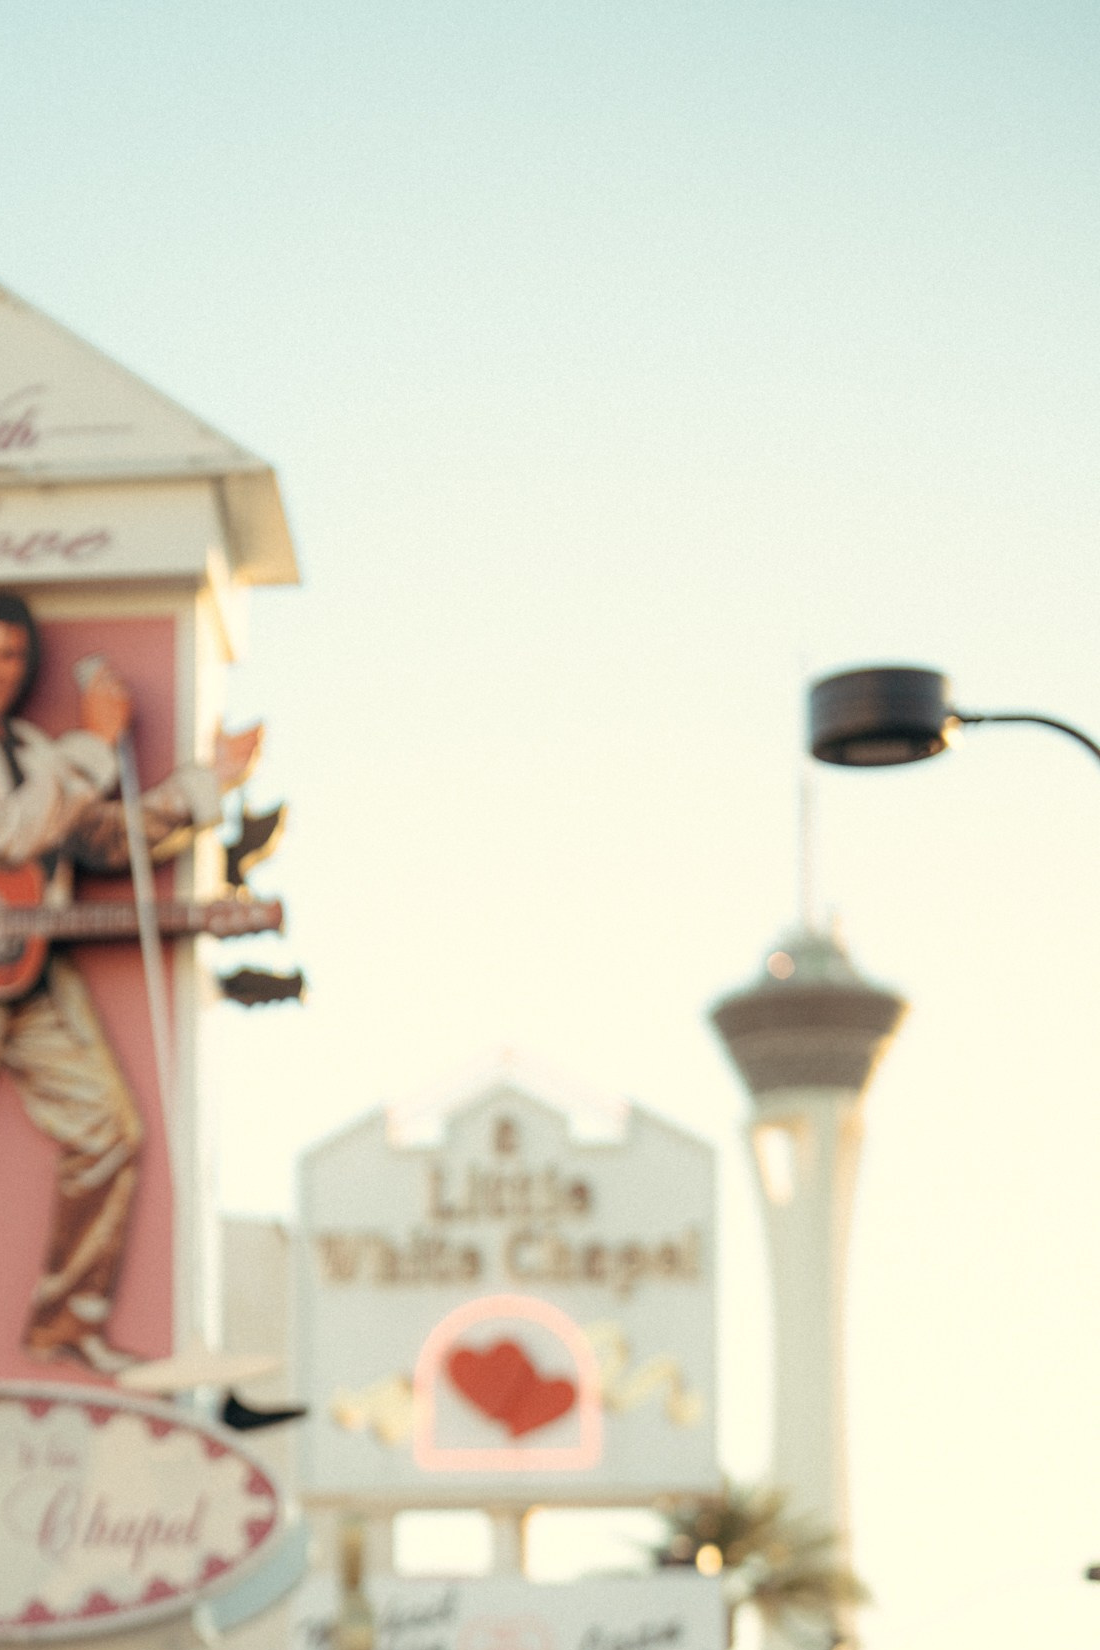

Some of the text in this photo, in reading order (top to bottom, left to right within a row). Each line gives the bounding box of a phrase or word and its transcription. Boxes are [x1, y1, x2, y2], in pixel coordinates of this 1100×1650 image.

[427, 1160, 594, 1222] Little
[314, 1226, 702, 1302] White Chapel
[3, 1478, 208, 1572] Chapel
